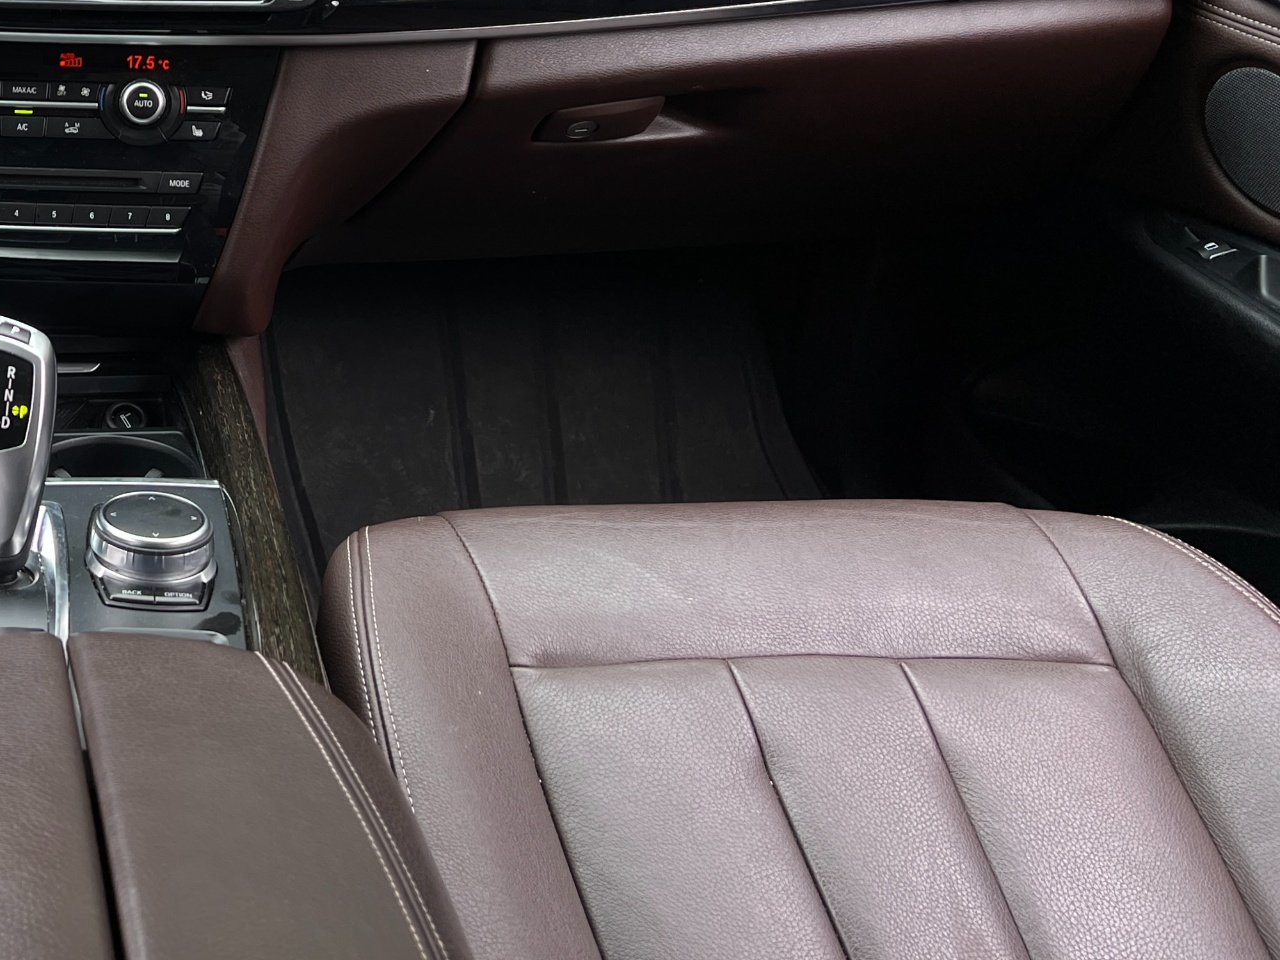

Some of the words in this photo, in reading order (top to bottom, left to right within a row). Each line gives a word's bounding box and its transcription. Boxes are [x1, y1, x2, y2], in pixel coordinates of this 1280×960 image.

[126, 55, 155, 70] 17.5
[16, 123, 28, 131] A/C
[169, 179, 190, 188] MODE
[14, 209, 19, 217] 4
[51, 210, 57, 218] 5
[89, 212, 95, 220] 6
[127, 212, 133, 220] 7
[7, 366, 16, 379] R
[4, 388, 14, 402] N
[1, 416, 10, 429] D
